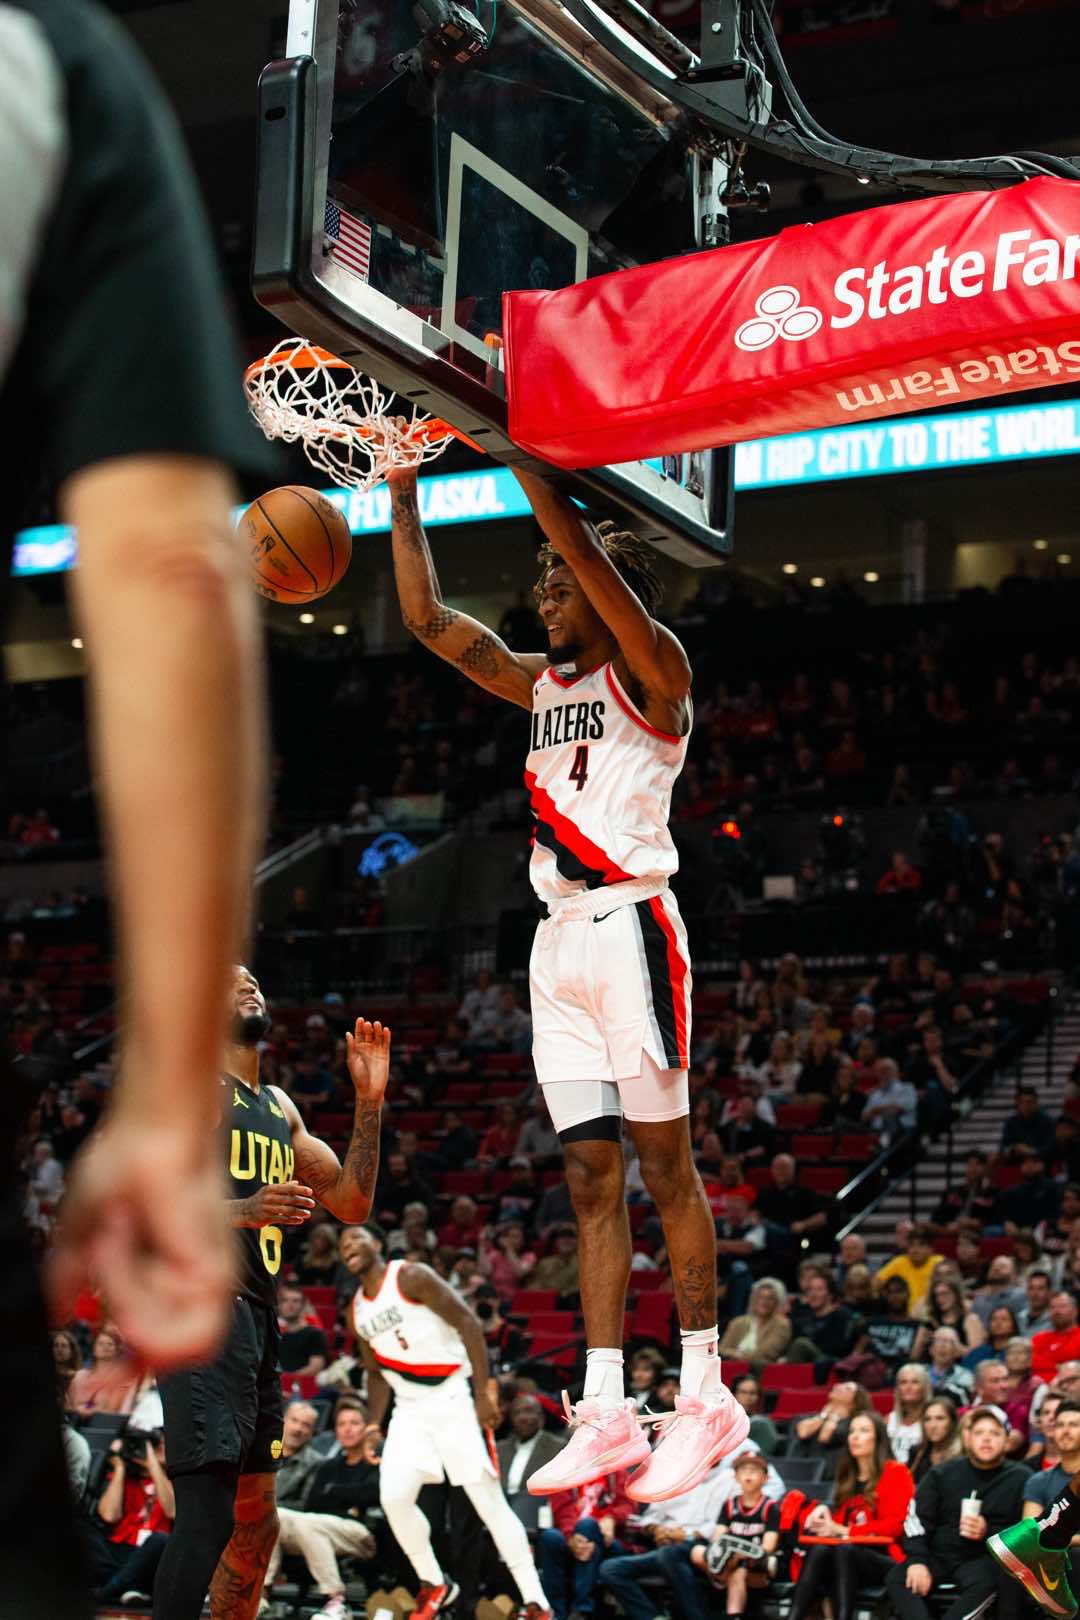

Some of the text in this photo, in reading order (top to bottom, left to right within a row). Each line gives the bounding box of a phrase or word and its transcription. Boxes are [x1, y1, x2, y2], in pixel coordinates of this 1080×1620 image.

[992, 229, 1080, 292] Far
[766, 438, 814, 481] RIP
[818, 429, 886, 474] CITY
[890, 424, 929, 467] TO
[932, 416, 992, 462] THE
[995, 407, 1080, 455] WORL
[417, 475, 506, 522] LASKA.
[532, 700, 605, 751] LAZERS
[568, 744, 589, 792] 4
[230, 1129, 294, 1185] UTAH
